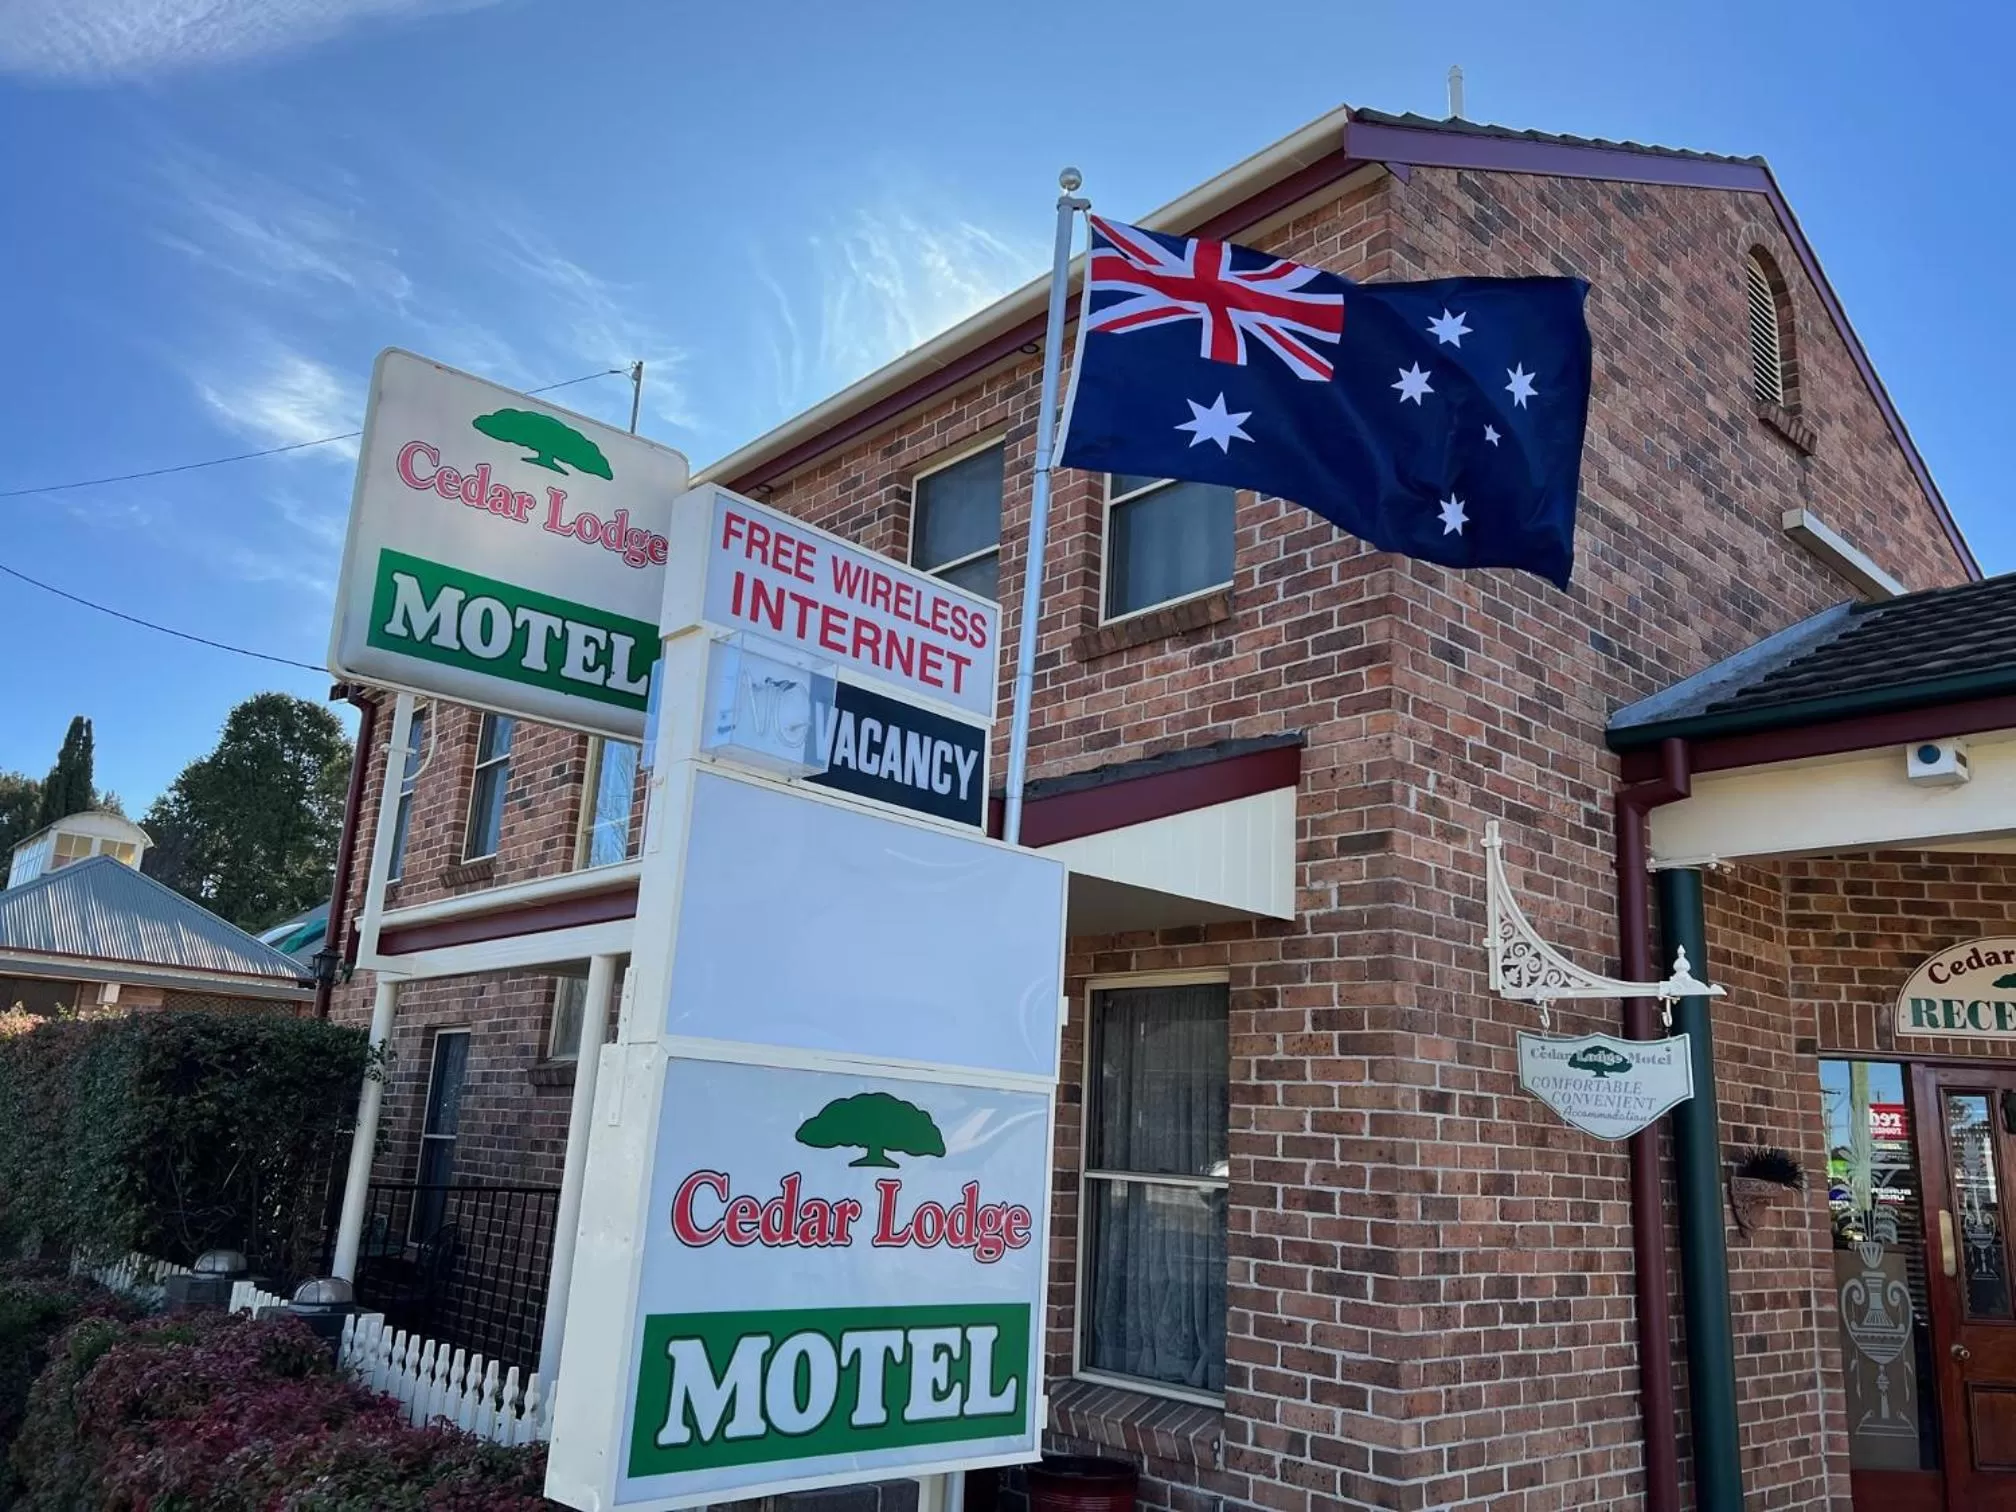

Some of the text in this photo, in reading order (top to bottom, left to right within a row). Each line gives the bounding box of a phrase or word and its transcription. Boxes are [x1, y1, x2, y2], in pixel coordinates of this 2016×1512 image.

[397, 441, 668, 568] Cedar Lodge
[722, 512, 987, 648] FREE WIRELESS
[384, 572, 648, 696] MOTEL
[731, 571, 972, 694] INTERNET
[814, 702, 979, 800] VACANCY
[1928, 947, 2015, 984] Cedar
[1530, 1049, 1570, 1061] Cedar
[1627, 1051, 1672, 1065] Motel
[1909, 998, 2016, 1031] RECE
[1531, 1076, 1642, 1095] COMFORTABLE
[1552, 1091, 1656, 1110] CONVENIENT
[1563, 1105, 1647, 1121] Accommodation
[672, 1170, 1031, 1264] Cedar Lodge
[655, 1324, 1018, 1448] MOTEL
